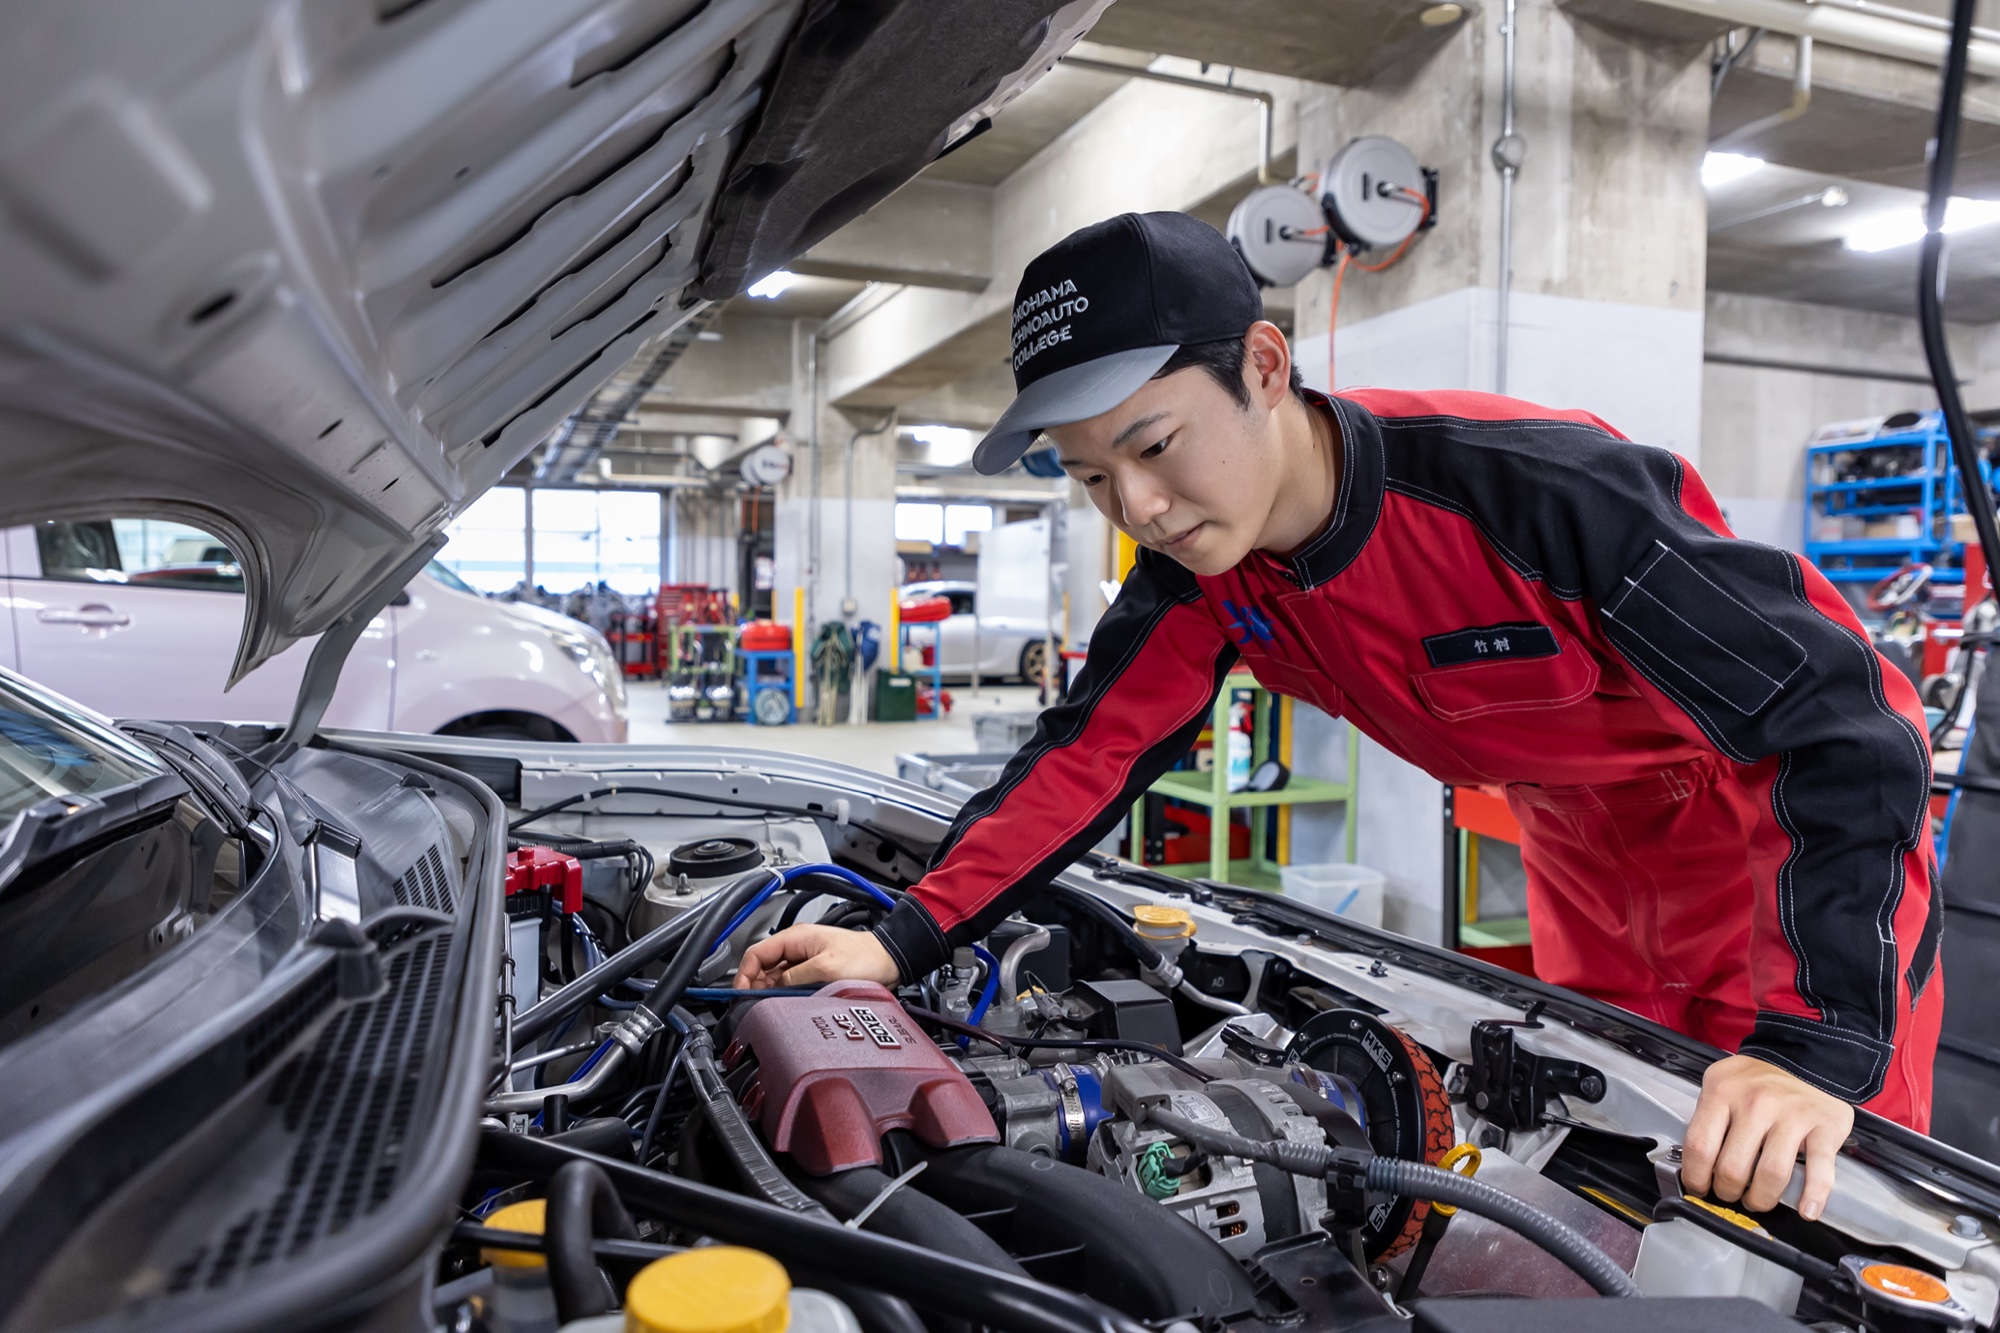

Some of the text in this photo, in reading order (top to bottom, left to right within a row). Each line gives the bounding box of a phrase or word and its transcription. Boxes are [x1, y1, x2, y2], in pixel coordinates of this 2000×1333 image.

[1012, 279, 1078, 328] OKOHAMA
[1012, 296, 1089, 352] CHNOAUTO
[1014, 324, 1072, 371] COLLEGE
[811, 1015, 838, 1040] TOYOTA
[853, 1008, 896, 1044] BOXER
[1363, 1030, 1392, 1068] HKS
